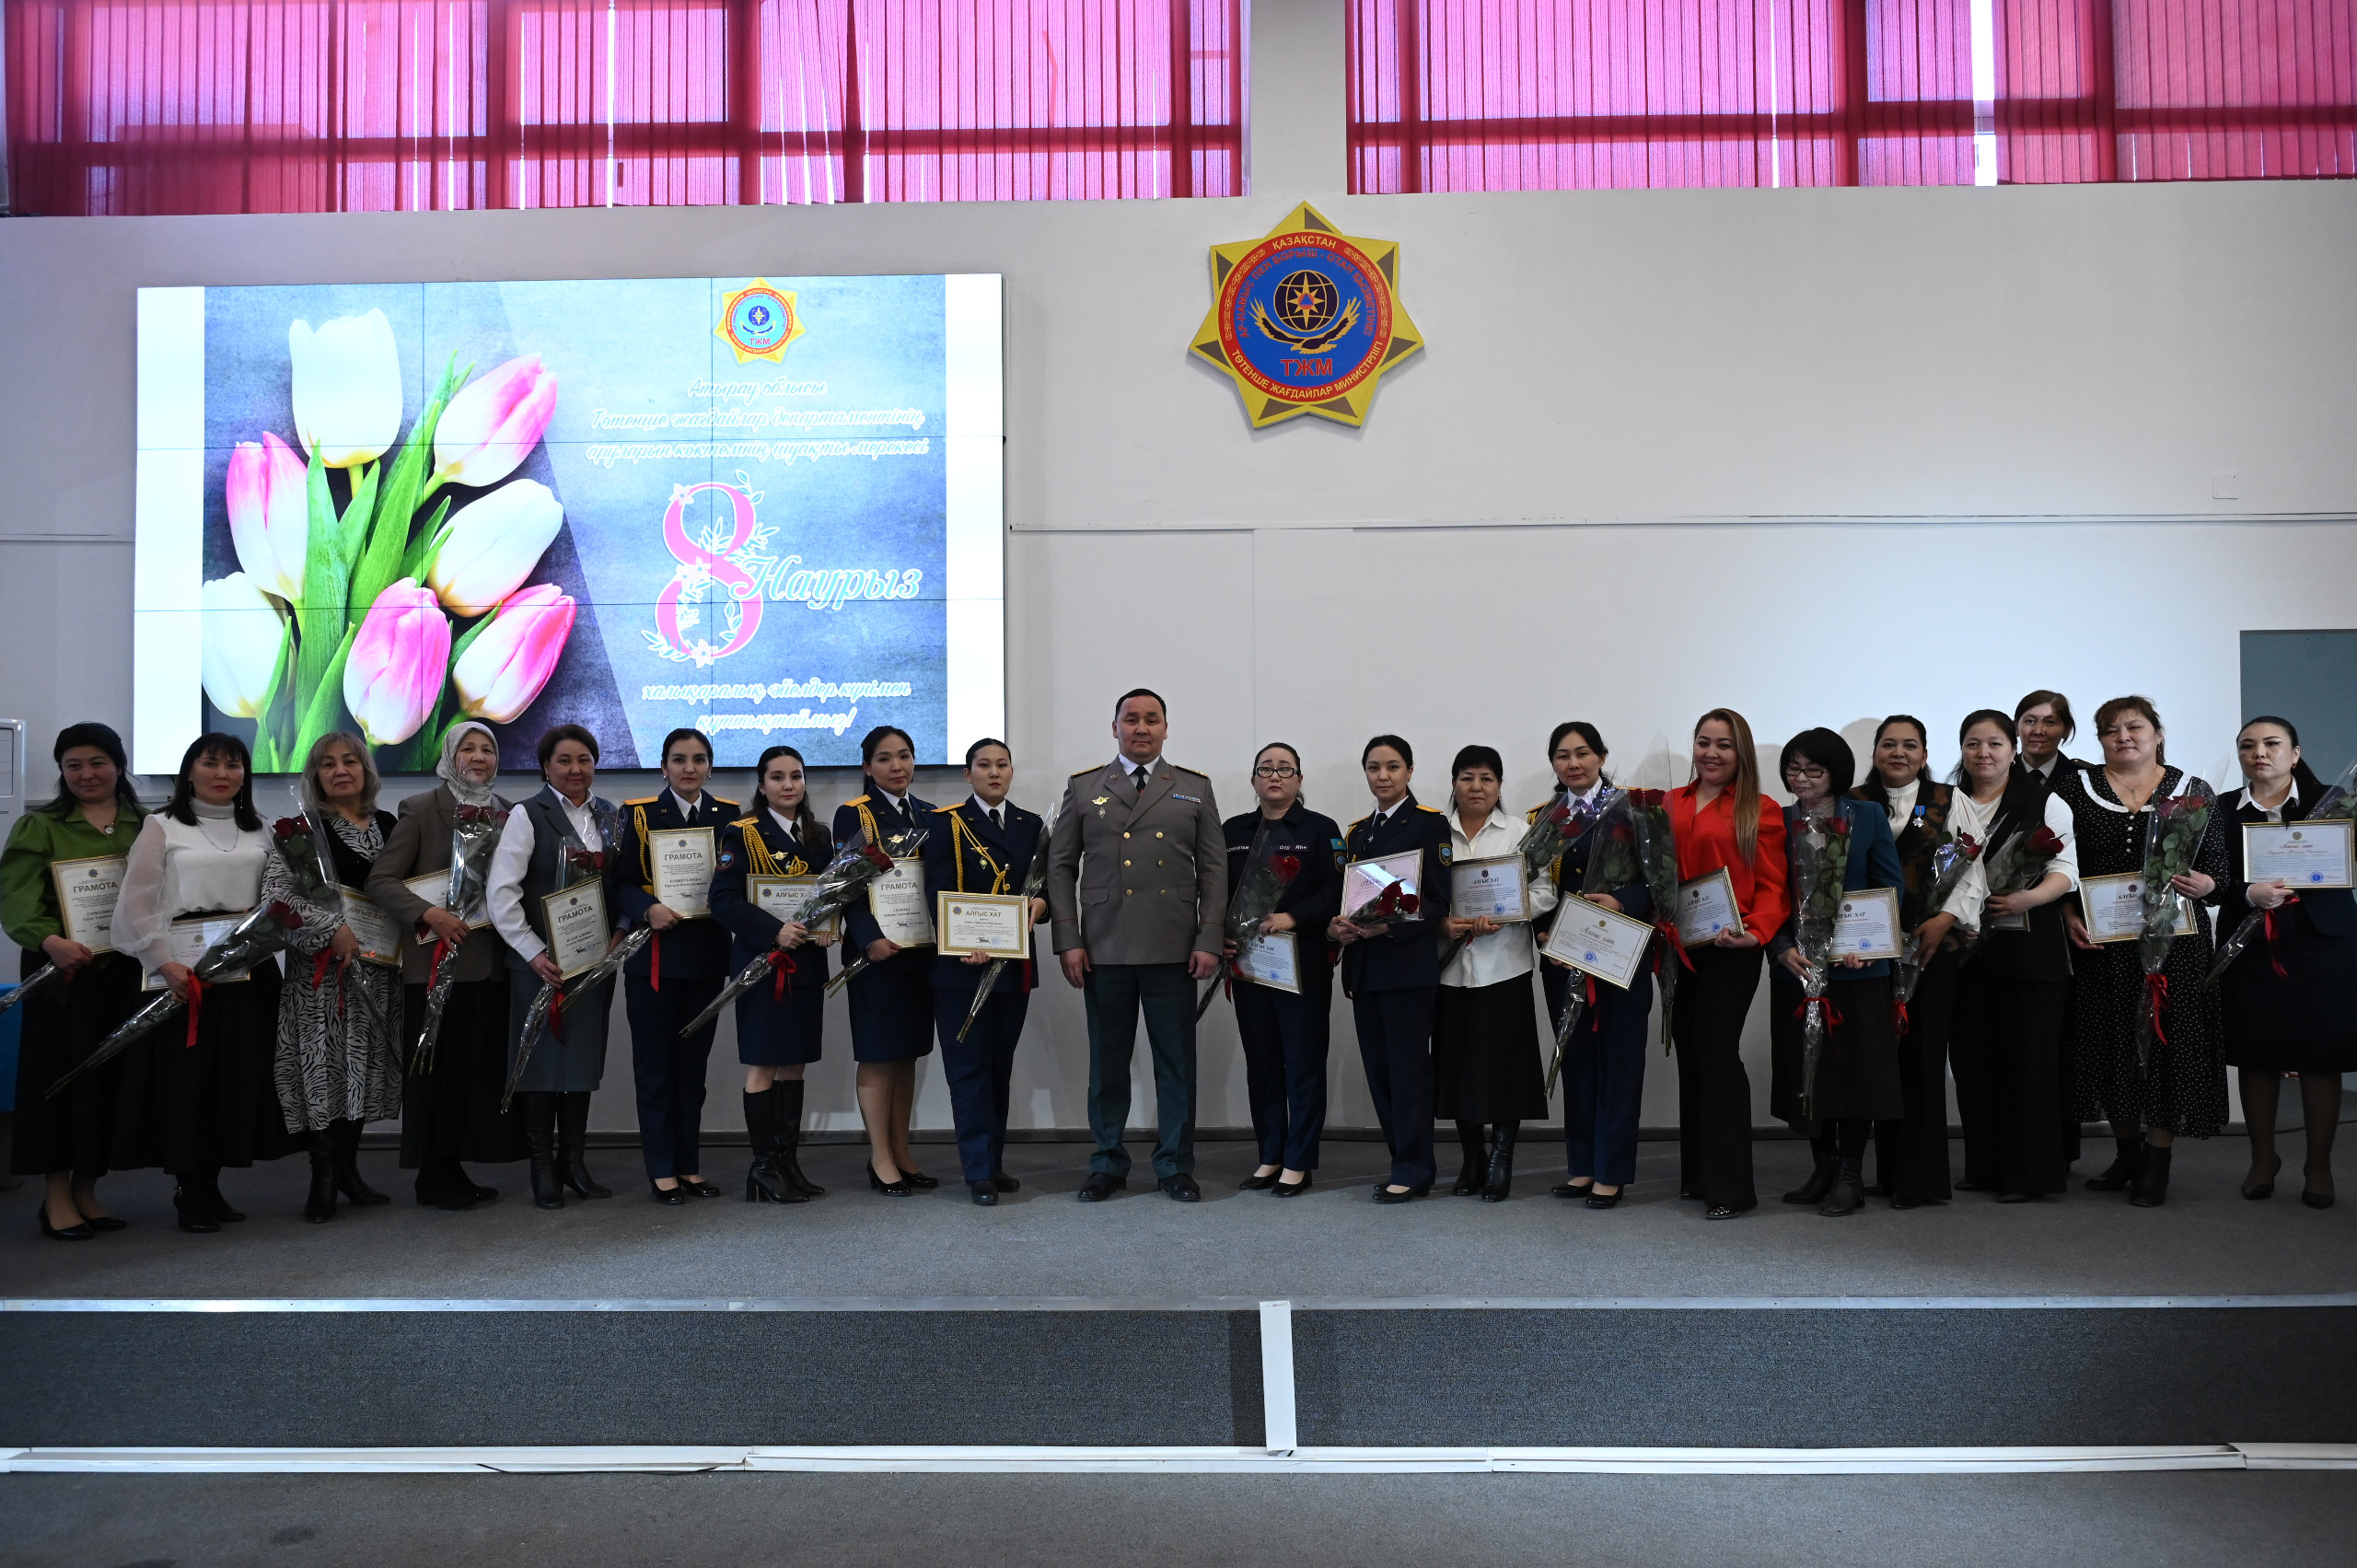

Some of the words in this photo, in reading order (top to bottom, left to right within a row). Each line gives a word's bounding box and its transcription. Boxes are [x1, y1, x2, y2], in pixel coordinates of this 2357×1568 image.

[1272, 235, 1337, 250] ҚАЗАҚСТАН
[1237, 281, 1255, 338] АР-НАМЫС
[1251, 261, 1272, 281] ПЕН
[1271, 249, 1318, 265] БОРЫШ
[1327, 254, 1354, 274] ОТАН
[1232, 348, 1270, 389] ТӨТЕНШЕ
[1270, 382, 1334, 400] ЖАҒДАЙЛАР
[1334, 341, 1385, 392] МИНИСТРЛІГІ
[1280, 358, 1333, 377] ТЖМ
[689, 377, 759, 404] Атырау
[762, 377, 827, 397] облысы
[591, 410, 669, 431] Төтенше
[770, 406, 925, 430] департаментінің
[586, 444, 674, 469] аруларын
[772, 441, 850, 465] шуақты
[850, 437, 930, 460] мерекесі
[656, 481, 763, 660] 8
[729, 555, 923, 610] Наурыз
[642, 683, 766, 705] халықаралық
[767, 677, 839, 703] әйелдер
[665, 852, 702, 861] ГРАМОТА
[74, 881, 118, 893] ГРАМОТА
[881, 882, 917, 891] ГРАМОТА
[558, 905, 593, 923] ГРАМОТА
